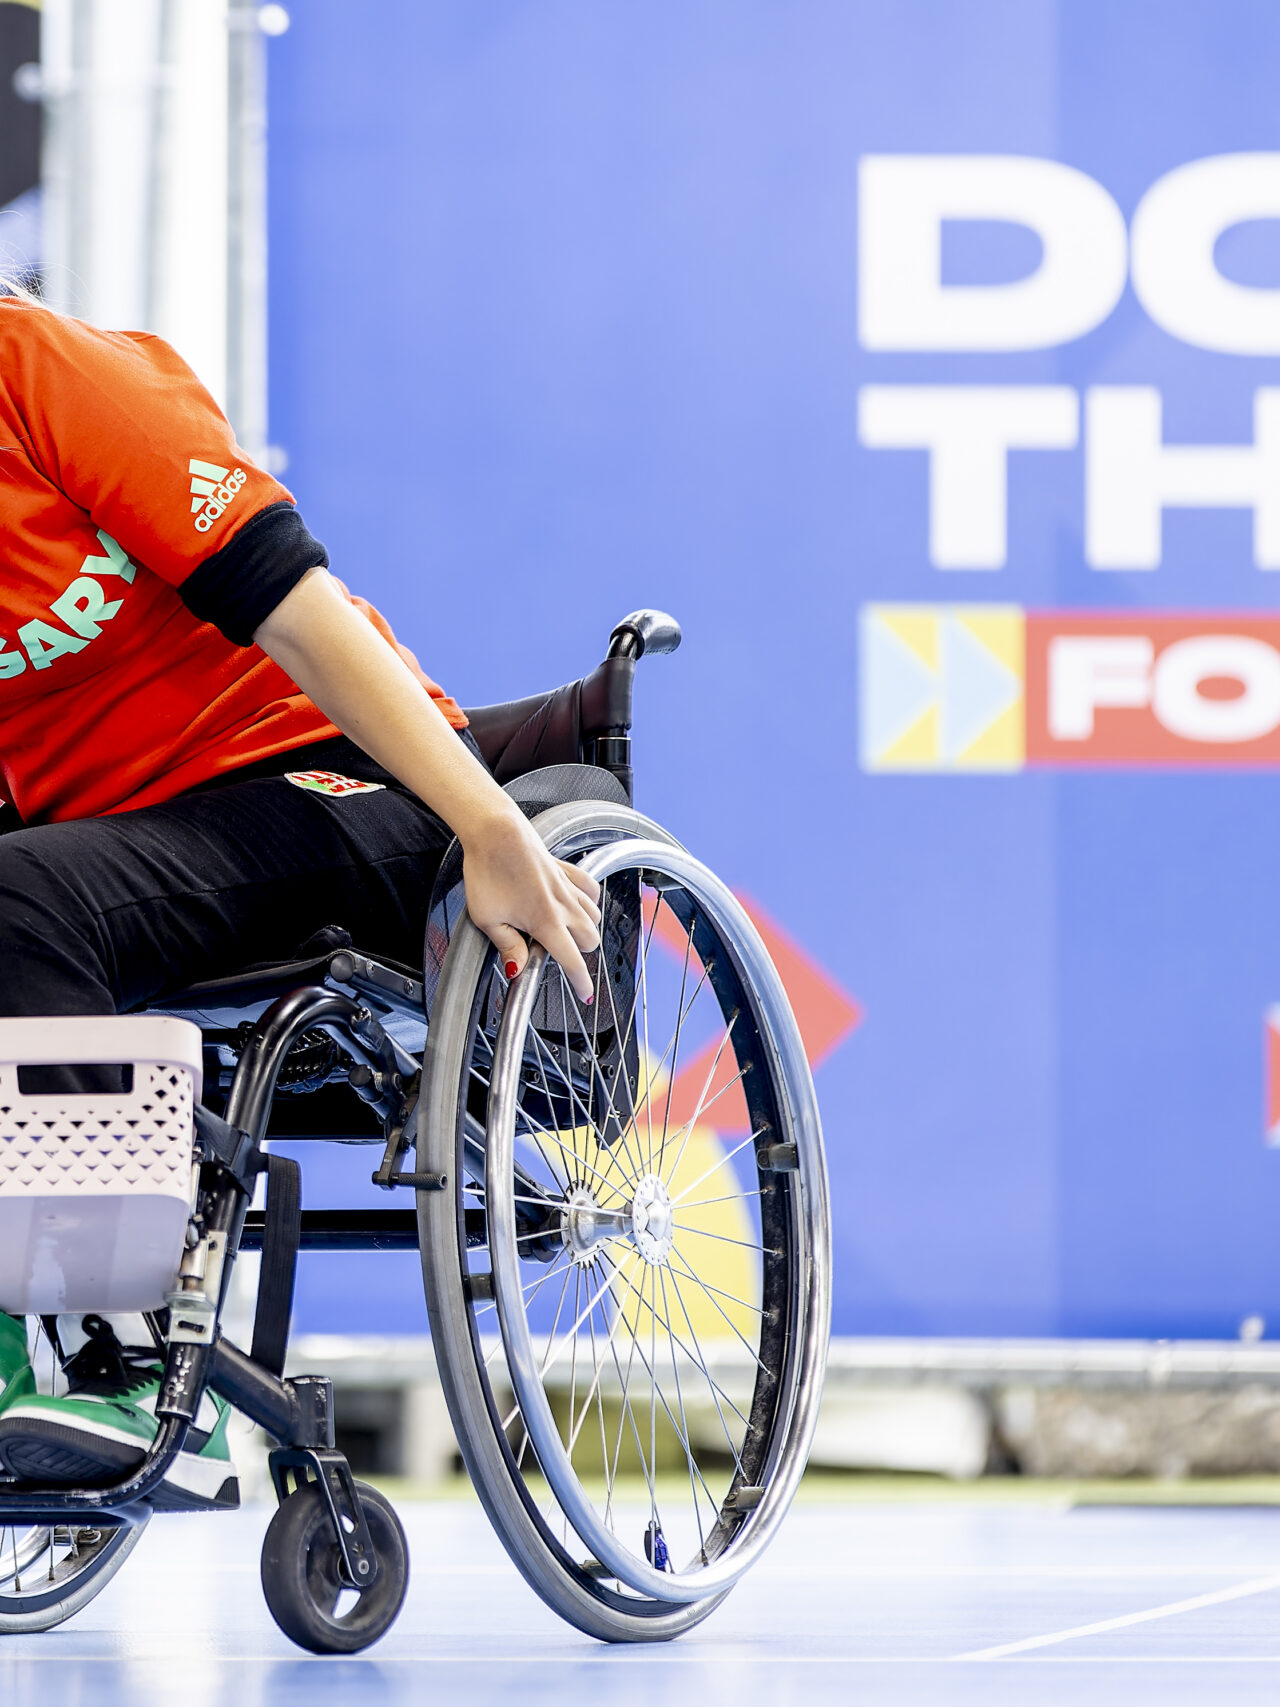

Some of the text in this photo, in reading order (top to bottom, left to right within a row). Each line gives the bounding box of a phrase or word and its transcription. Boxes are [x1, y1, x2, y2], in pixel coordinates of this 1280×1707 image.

[194, 467, 247, 533] adidas
[857, 385, 1280, 571] TH
[1048, 634, 1280, 743] FO
